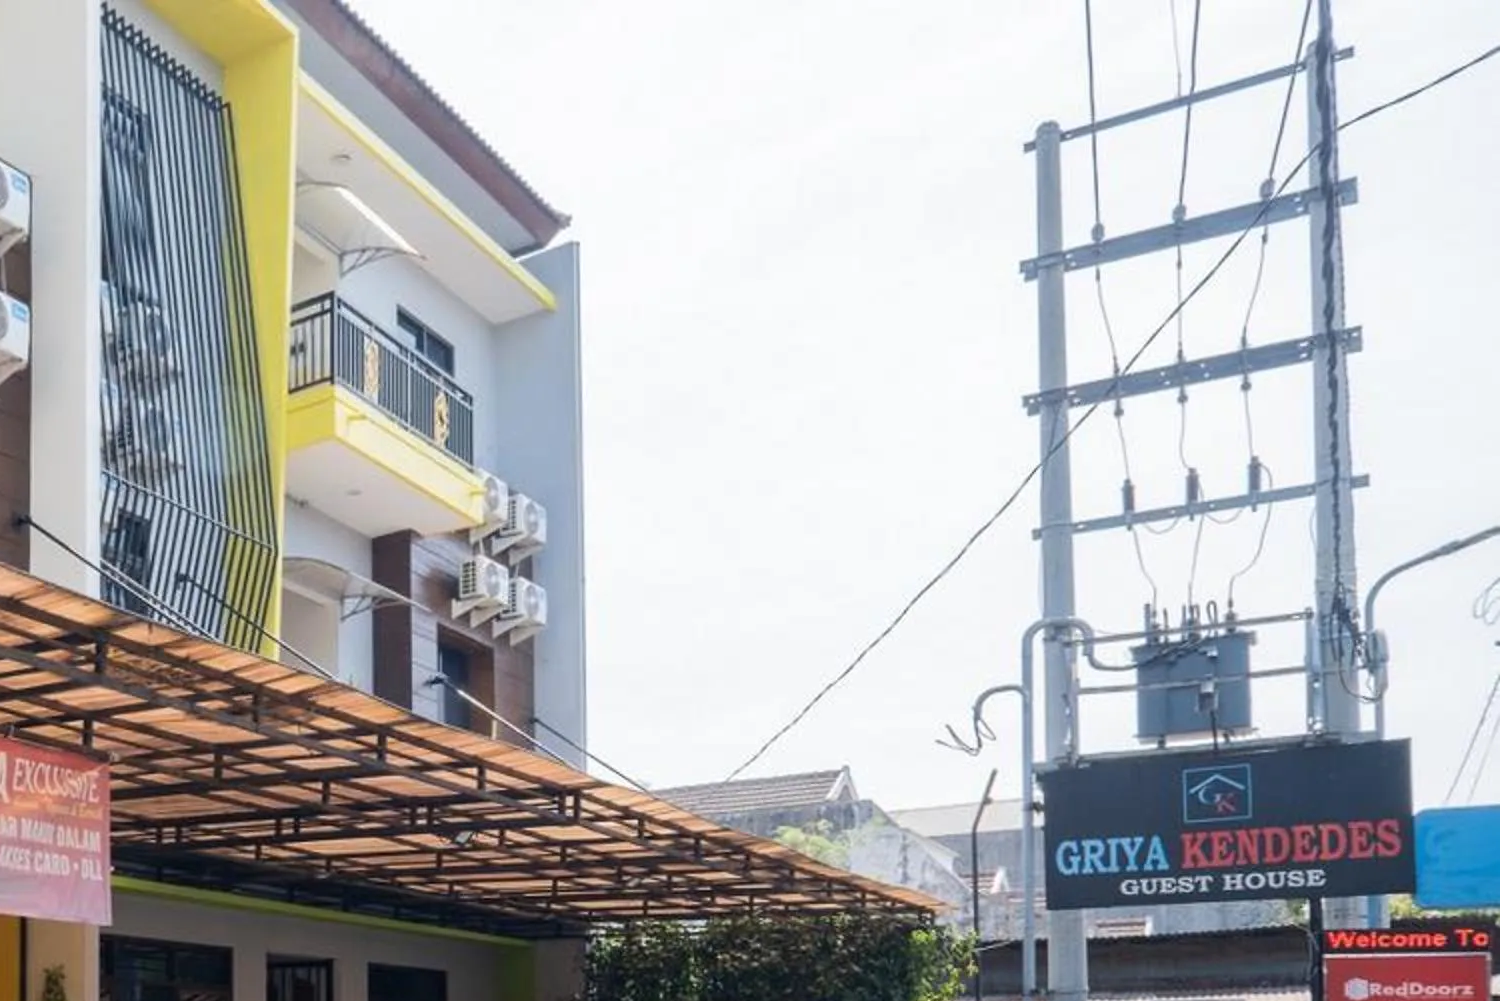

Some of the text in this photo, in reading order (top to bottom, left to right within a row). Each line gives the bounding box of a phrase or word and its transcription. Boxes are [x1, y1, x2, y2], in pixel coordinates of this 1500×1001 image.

[57, 826, 101, 853] DALAM
[1055, 818, 1402, 876] GRIYA KENDEDES
[33, 849, 70, 876] CARD
[1119, 869, 1328, 896] GUEST HOUSE
[1328, 928, 1490, 948] Welcome To
[1369, 981, 1475, 996] RedDoorz
